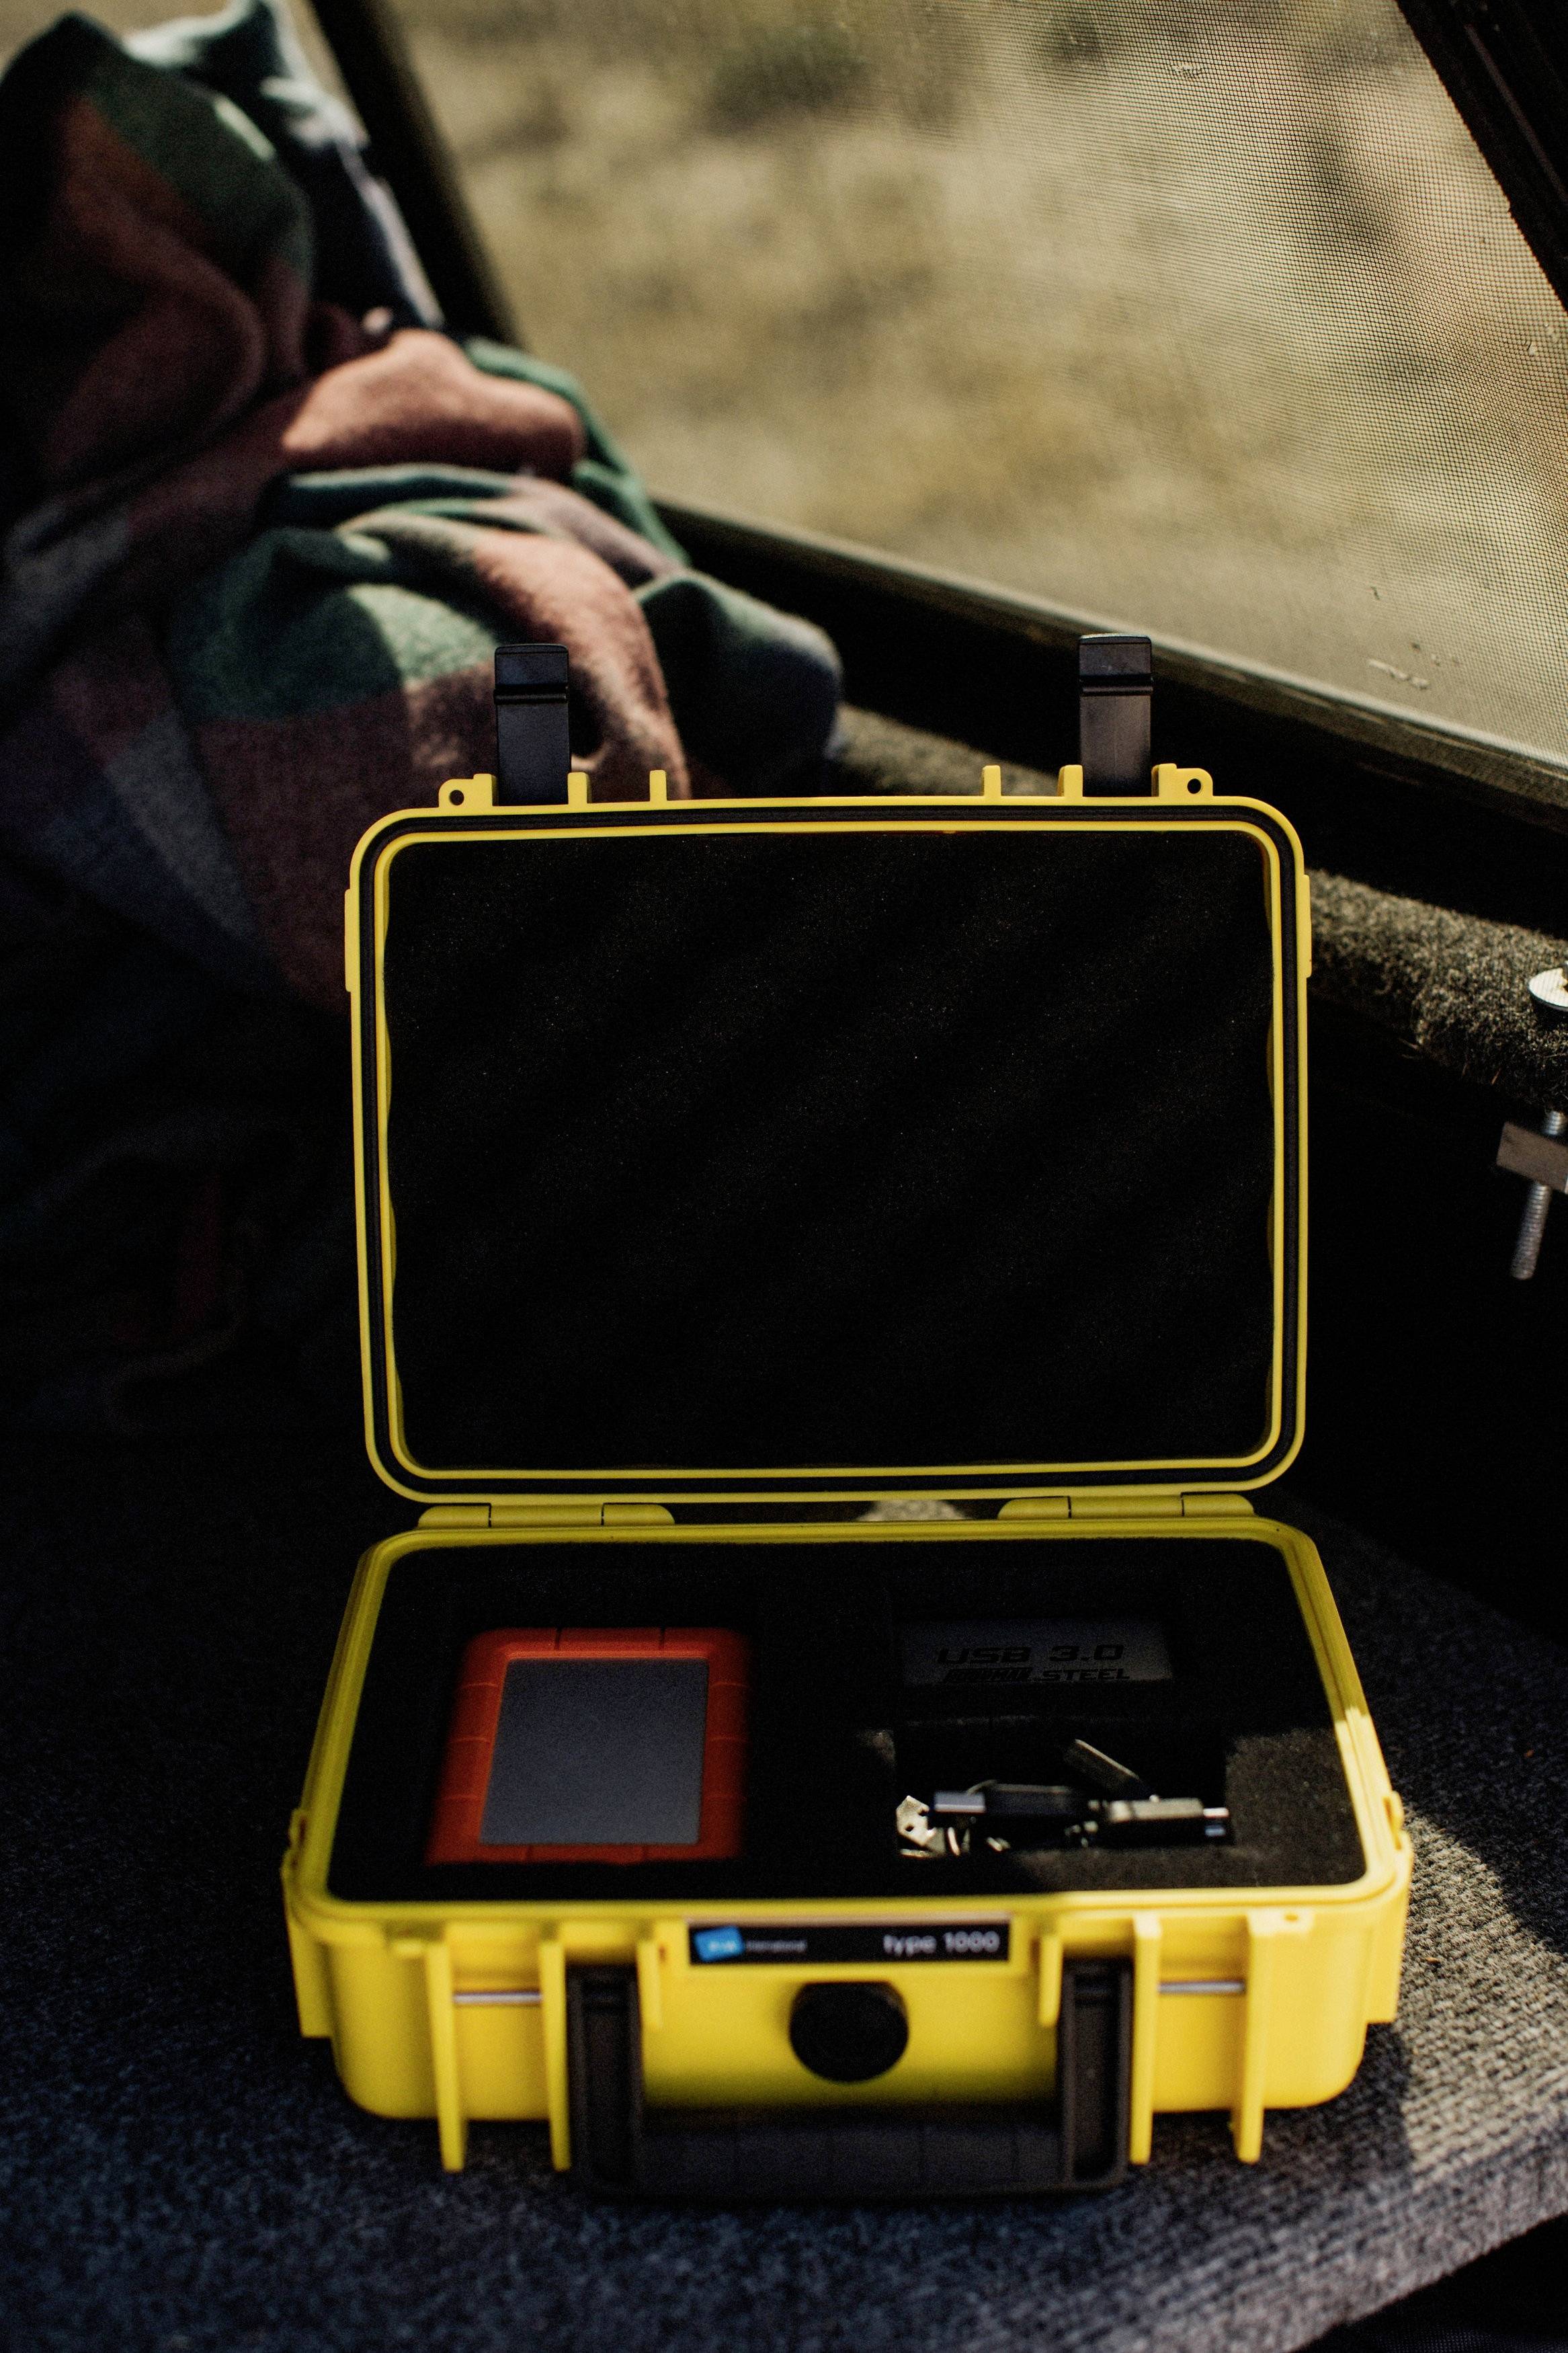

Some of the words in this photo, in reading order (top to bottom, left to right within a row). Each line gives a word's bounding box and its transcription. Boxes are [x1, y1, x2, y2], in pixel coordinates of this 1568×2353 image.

[938, 1645, 1031, 1664] USB
[1049, 1643, 1125, 1661] 3.0
[1044, 1669, 1130, 1681] STEEL
[944, 1930, 999, 1953] 1000
